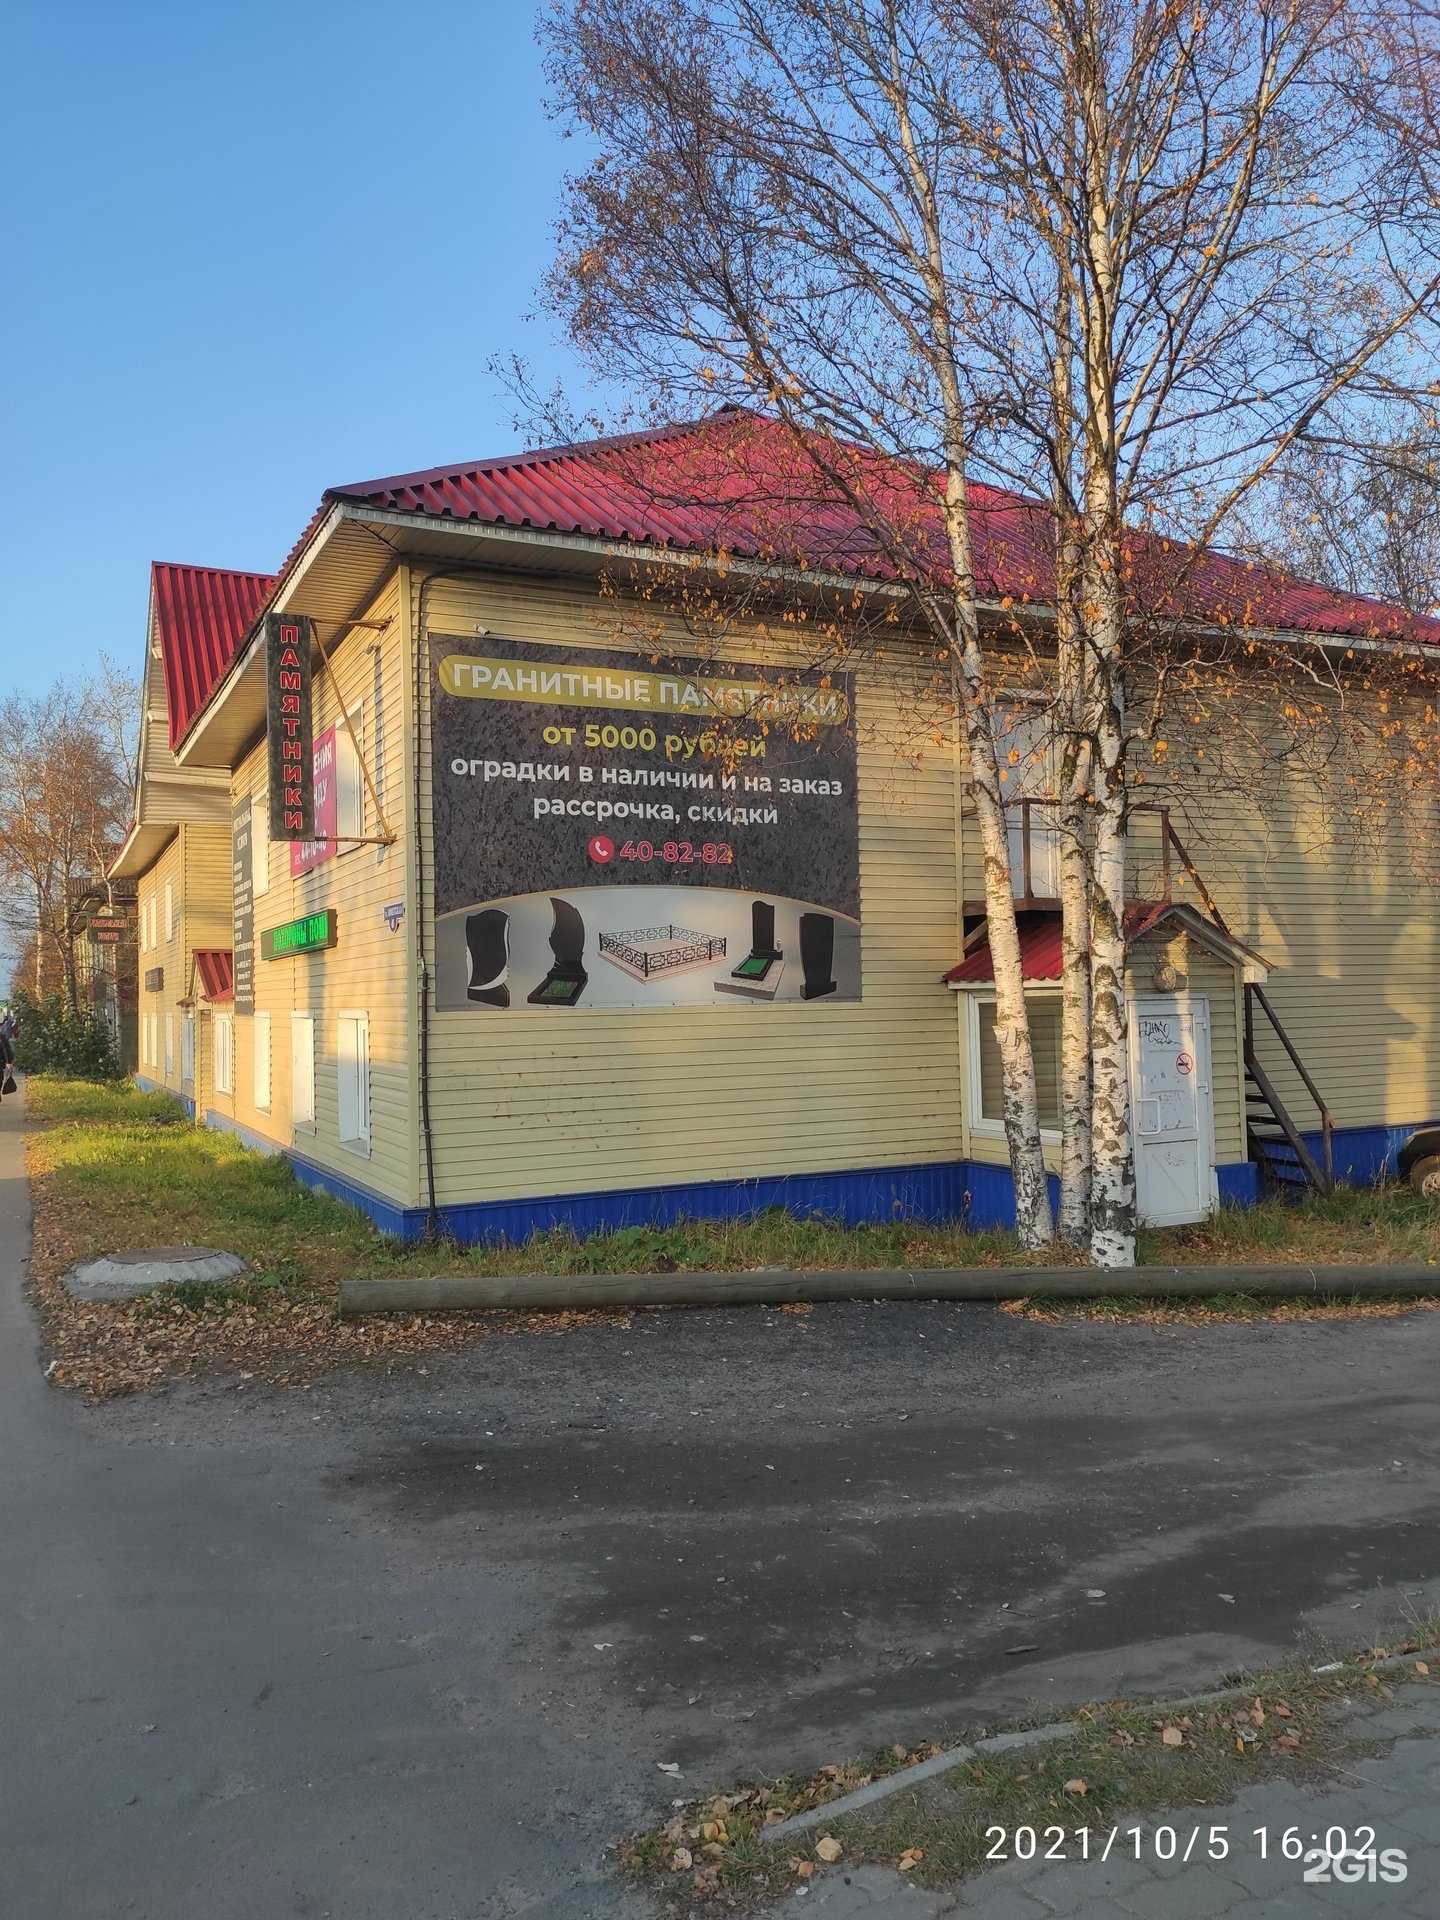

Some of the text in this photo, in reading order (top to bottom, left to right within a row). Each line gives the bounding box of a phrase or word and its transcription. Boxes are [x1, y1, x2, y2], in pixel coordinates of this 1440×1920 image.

[453, 664, 838, 716] ГРАНИТНЫЕ ПАМЯТКИ
[280, 625, 303, 829] ПАМЯТНИКИ
[543, 726, 577, 746] от
[584, 725, 657, 751] 5000
[451, 759, 843, 796] оградки в наличии и на заказ
[533, 797, 778, 825] рассрочка, скидки
[619, 840, 732, 864] 40-82-82
